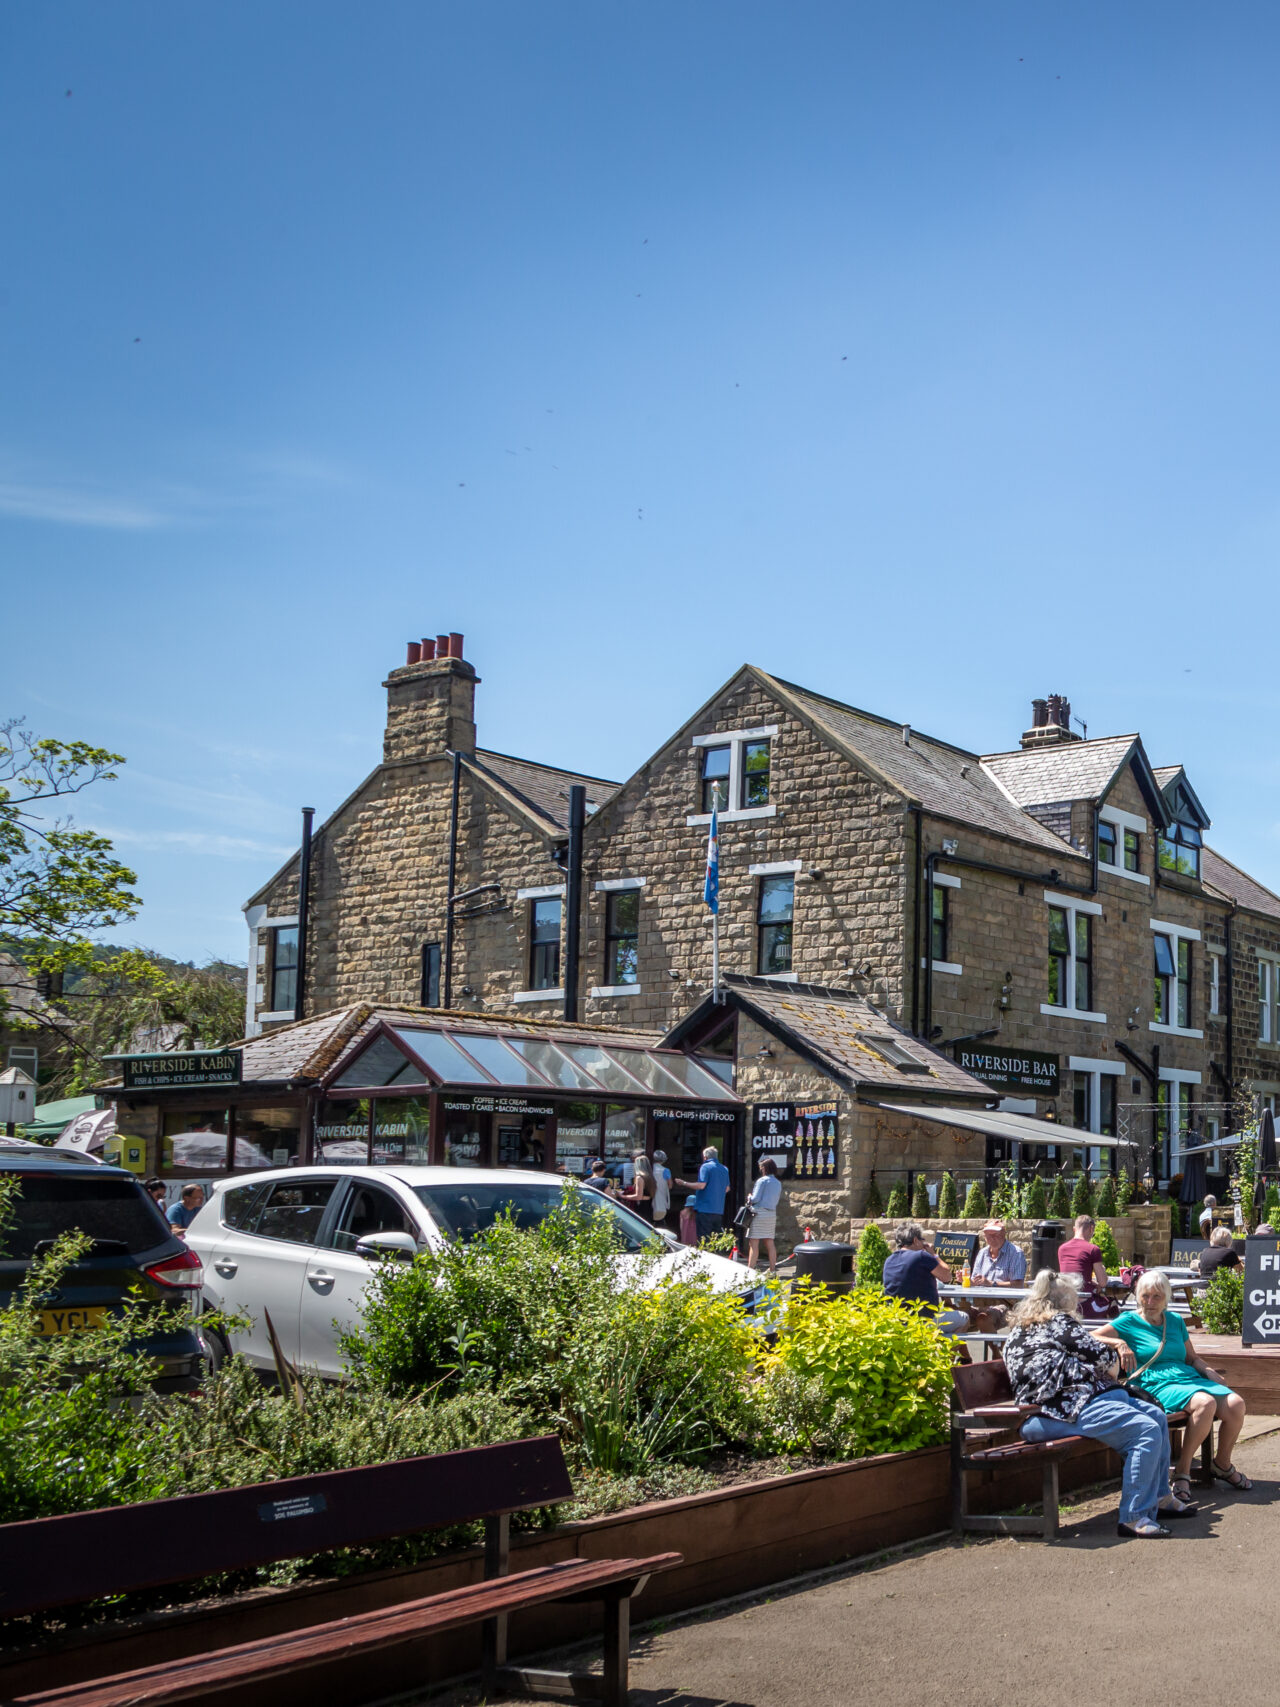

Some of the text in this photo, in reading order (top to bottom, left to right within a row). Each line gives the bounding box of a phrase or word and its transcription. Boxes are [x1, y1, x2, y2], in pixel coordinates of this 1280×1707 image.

[131, 1055, 236, 1074] RIVERSIDE KABIN
[961, 1052, 1057, 1077] RIVERSIDE BAR
[183, 1073, 205, 1082] CREAM
[208, 1072, 233, 1081] SNACKS
[988, 1073, 1008, 1082] DINING
[1021, 1076, 1051, 1086] FREE HOUSE
[473, 1096, 495, 1105] COFFEE
[508, 1099, 528, 1107] CREAM
[444, 1102, 471, 1111] TOASTED
[476, 1104, 494, 1112] CAKES
[498, 1106, 554, 1115] BACON SANDWICHES
[652, 1109, 695, 1119] FISH & CHIPS
[699, 1112, 735, 1122] HOT FOOD
[758, 1108, 789, 1121] FISH
[318, 1123, 409, 1137] RIVERSIDE KABIN
[556, 1127, 629, 1138] RIVERSIDE KABIN
[768, 1122, 778, 1134] &
[752, 1135, 794, 1149] CHIPS
[941, 1236, 968, 1246] Toasted
[934, 1247, 970, 1258] T.CAKE
[51, 1311, 99, 1332] YCL
